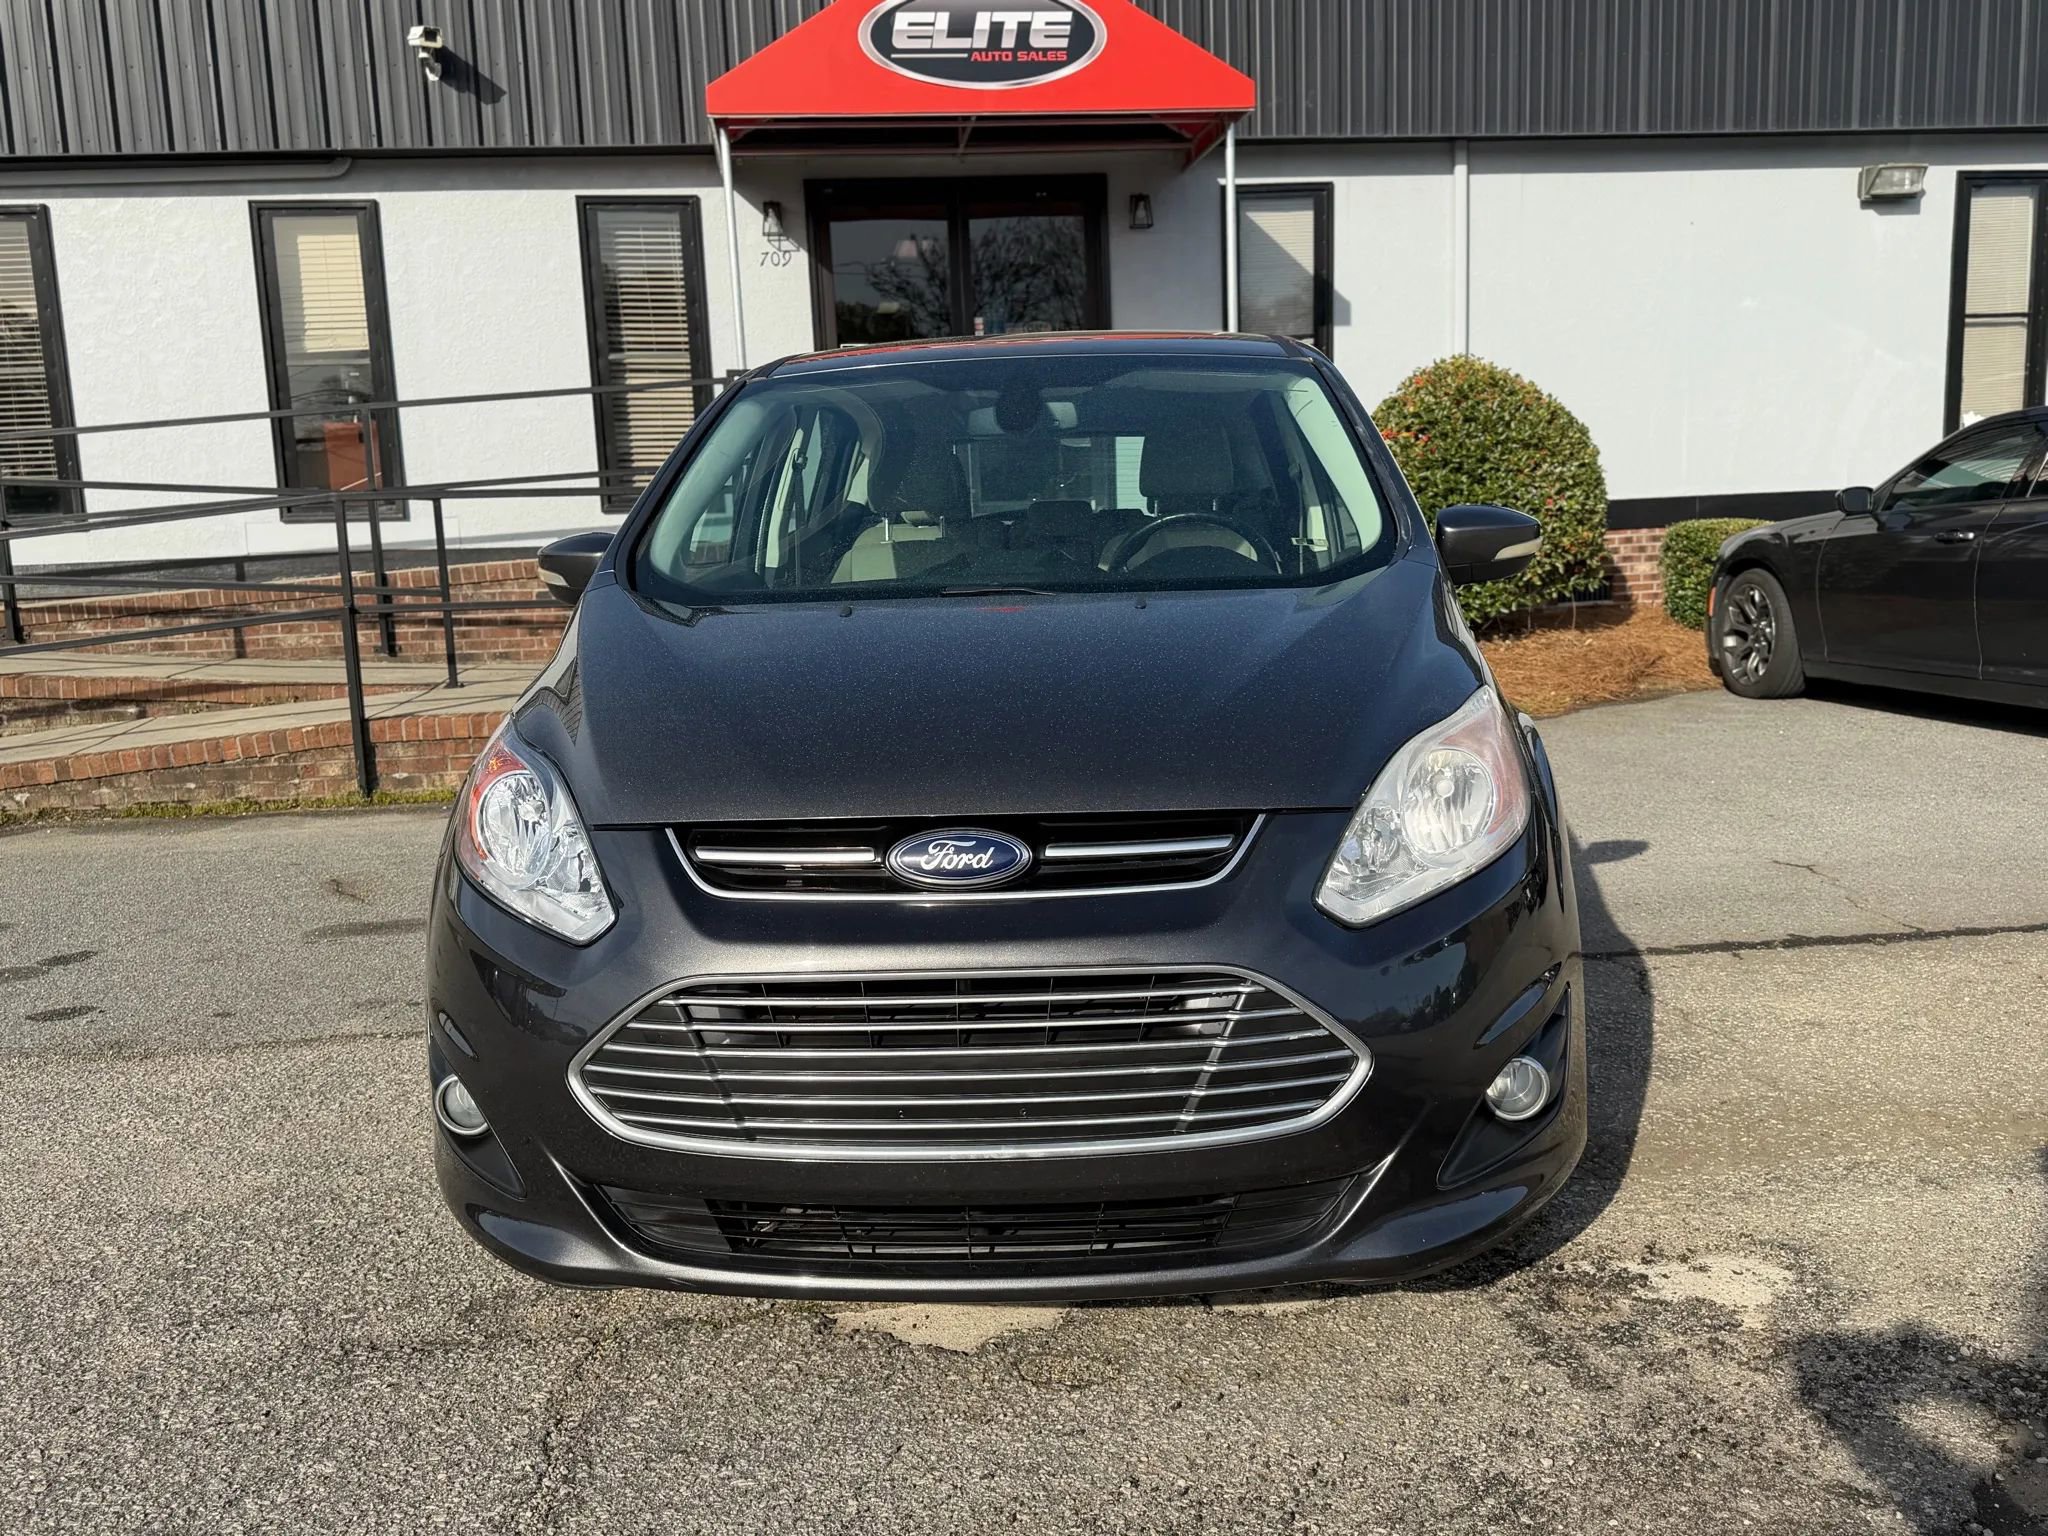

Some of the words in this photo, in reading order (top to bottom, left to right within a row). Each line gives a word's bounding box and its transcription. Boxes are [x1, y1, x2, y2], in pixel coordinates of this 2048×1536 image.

[891, 11, 1073, 49] ELITE
[970, 51, 1013, 62] AUTO
[1017, 50, 1068, 61] SALES
[760, 250, 792, 268] 709
[920, 839, 995, 871] Ford
